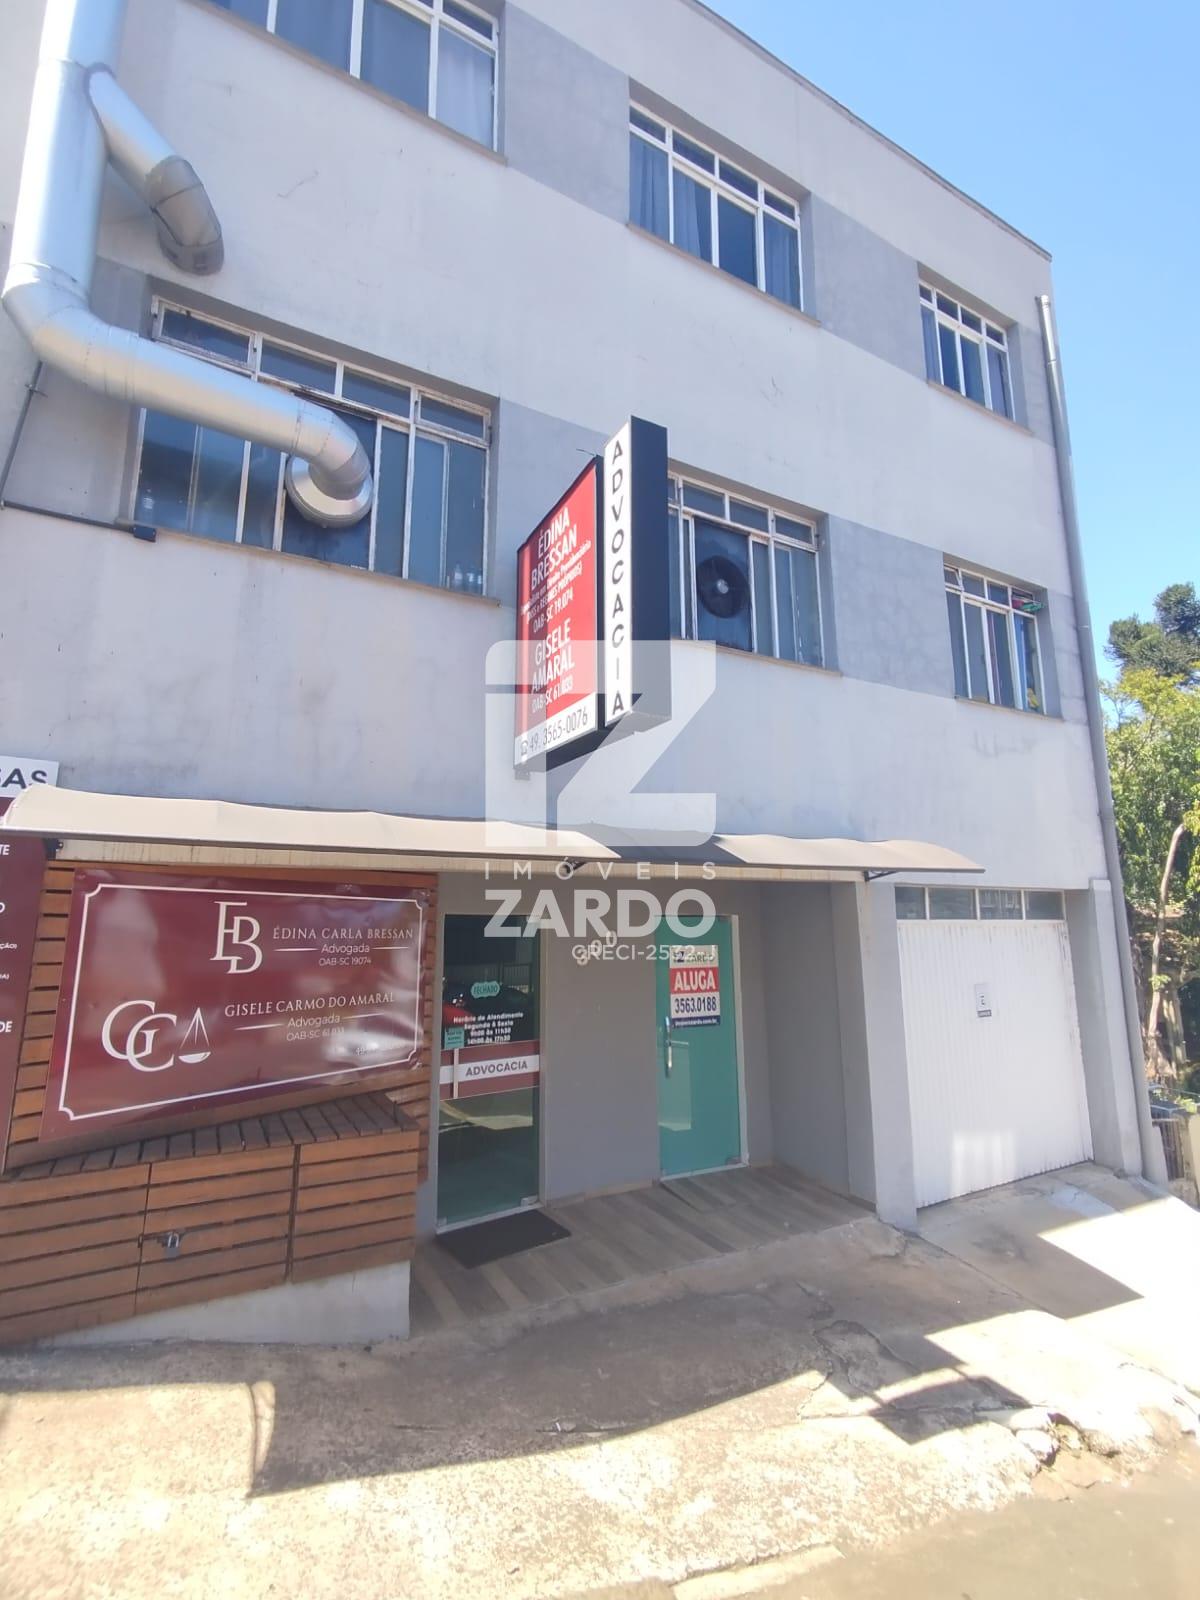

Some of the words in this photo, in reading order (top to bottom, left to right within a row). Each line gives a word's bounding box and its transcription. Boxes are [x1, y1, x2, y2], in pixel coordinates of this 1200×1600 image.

[538, 507, 570, 558] ÉDINA
[531, 524, 577, 590] BRESSAN
[611, 439, 625, 716] ADVOCACIA
[535, 618, 571, 665] GISELE
[531, 645, 575, 695] AMARAL
[543, 706, 588, 746] 3565-0076
[0, 768, 47, 789] AS
[273, 926, 316, 939] ÉDINA
[322, 928, 363, 939] CARLA
[367, 928, 413, 939] BRESSAN
[321, 944, 370, 955] Advogada
[319, 957, 350, 966] OAB-SC
[674, 970, 716, 991] ALUGA
[225, 1002, 272, 1017] GISELE
[276, 998, 326, 1013] CARMO
[328, 996, 346, 1008] DO
[349, 992, 395, 1006] AMARAL
[675, 996, 717, 1013] 3563.0188
[287, 1013, 341, 1028] Advogada
[287, 1030, 320, 1041] OAB-SC
[466, 1061, 528, 1076] ADVOCACIA
